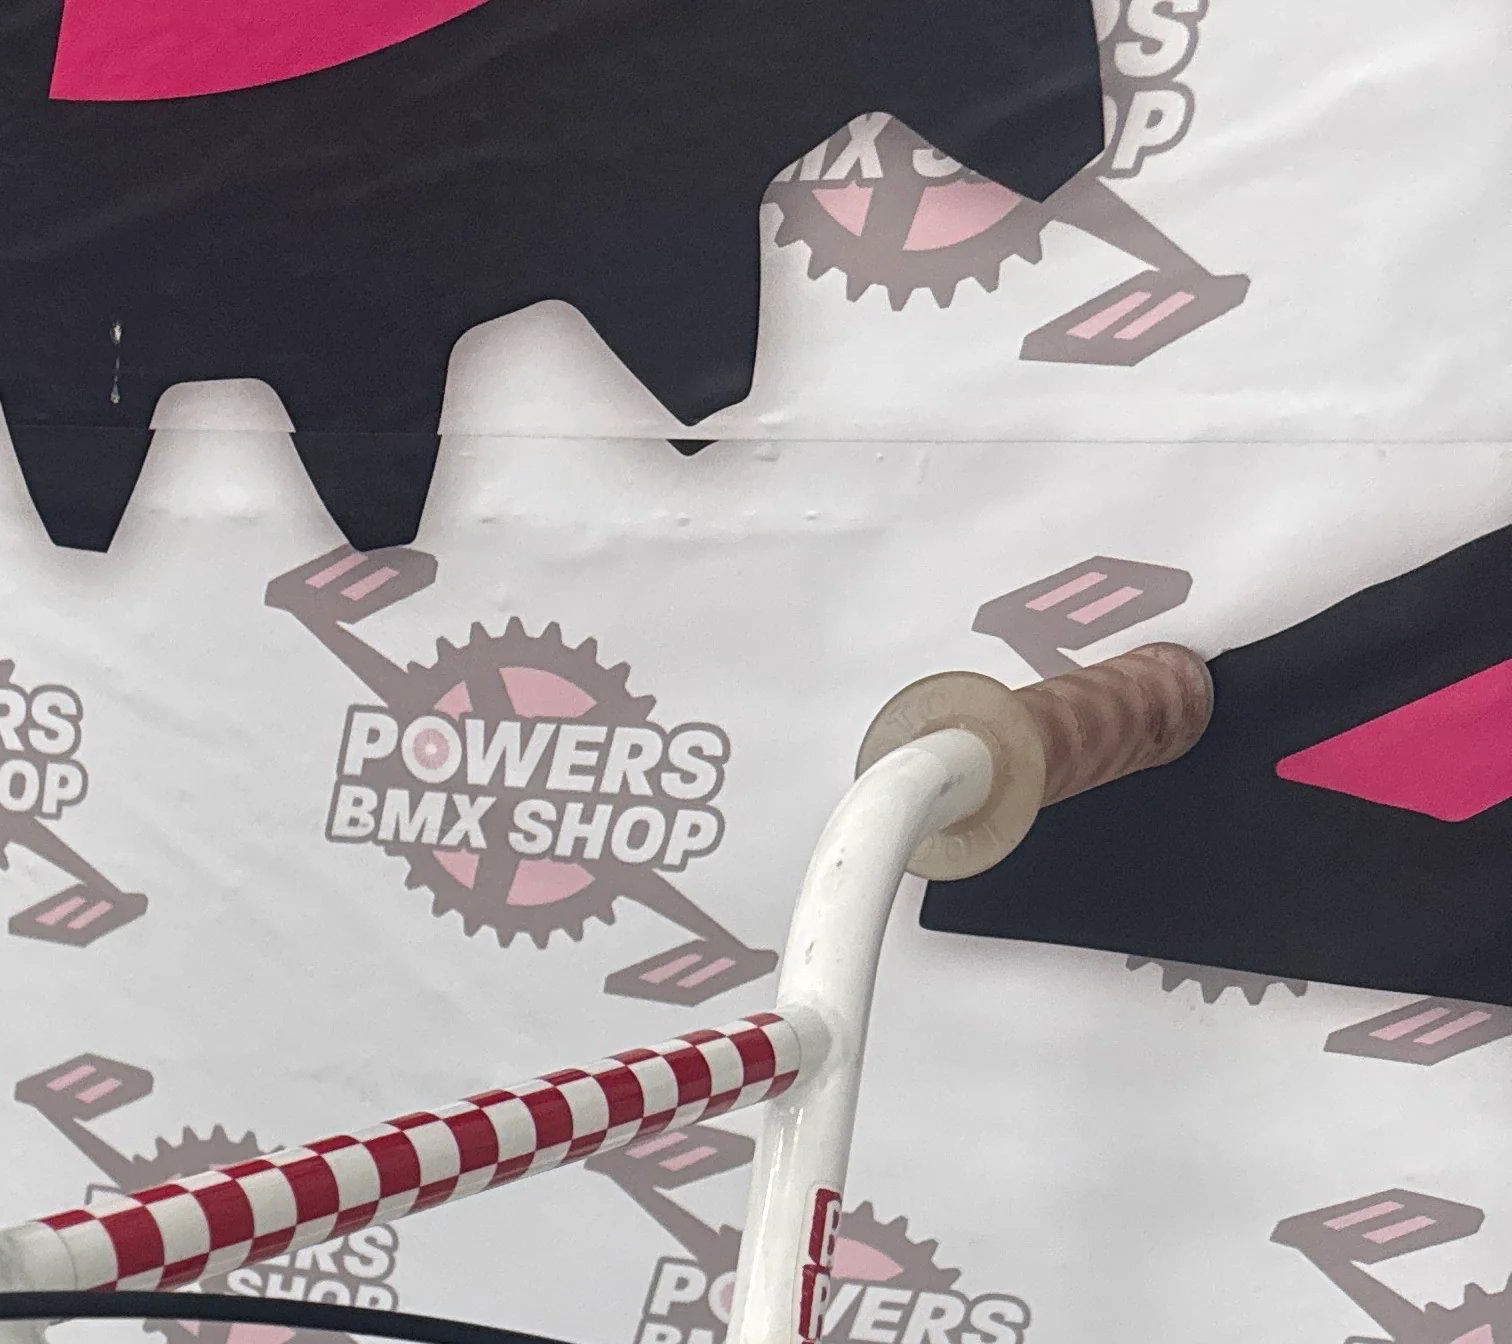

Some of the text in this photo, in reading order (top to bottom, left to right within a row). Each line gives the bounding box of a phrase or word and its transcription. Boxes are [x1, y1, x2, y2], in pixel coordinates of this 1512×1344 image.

[342, 711, 728, 800] POWERS
[331, 785, 723, 868] BMX SHOP
